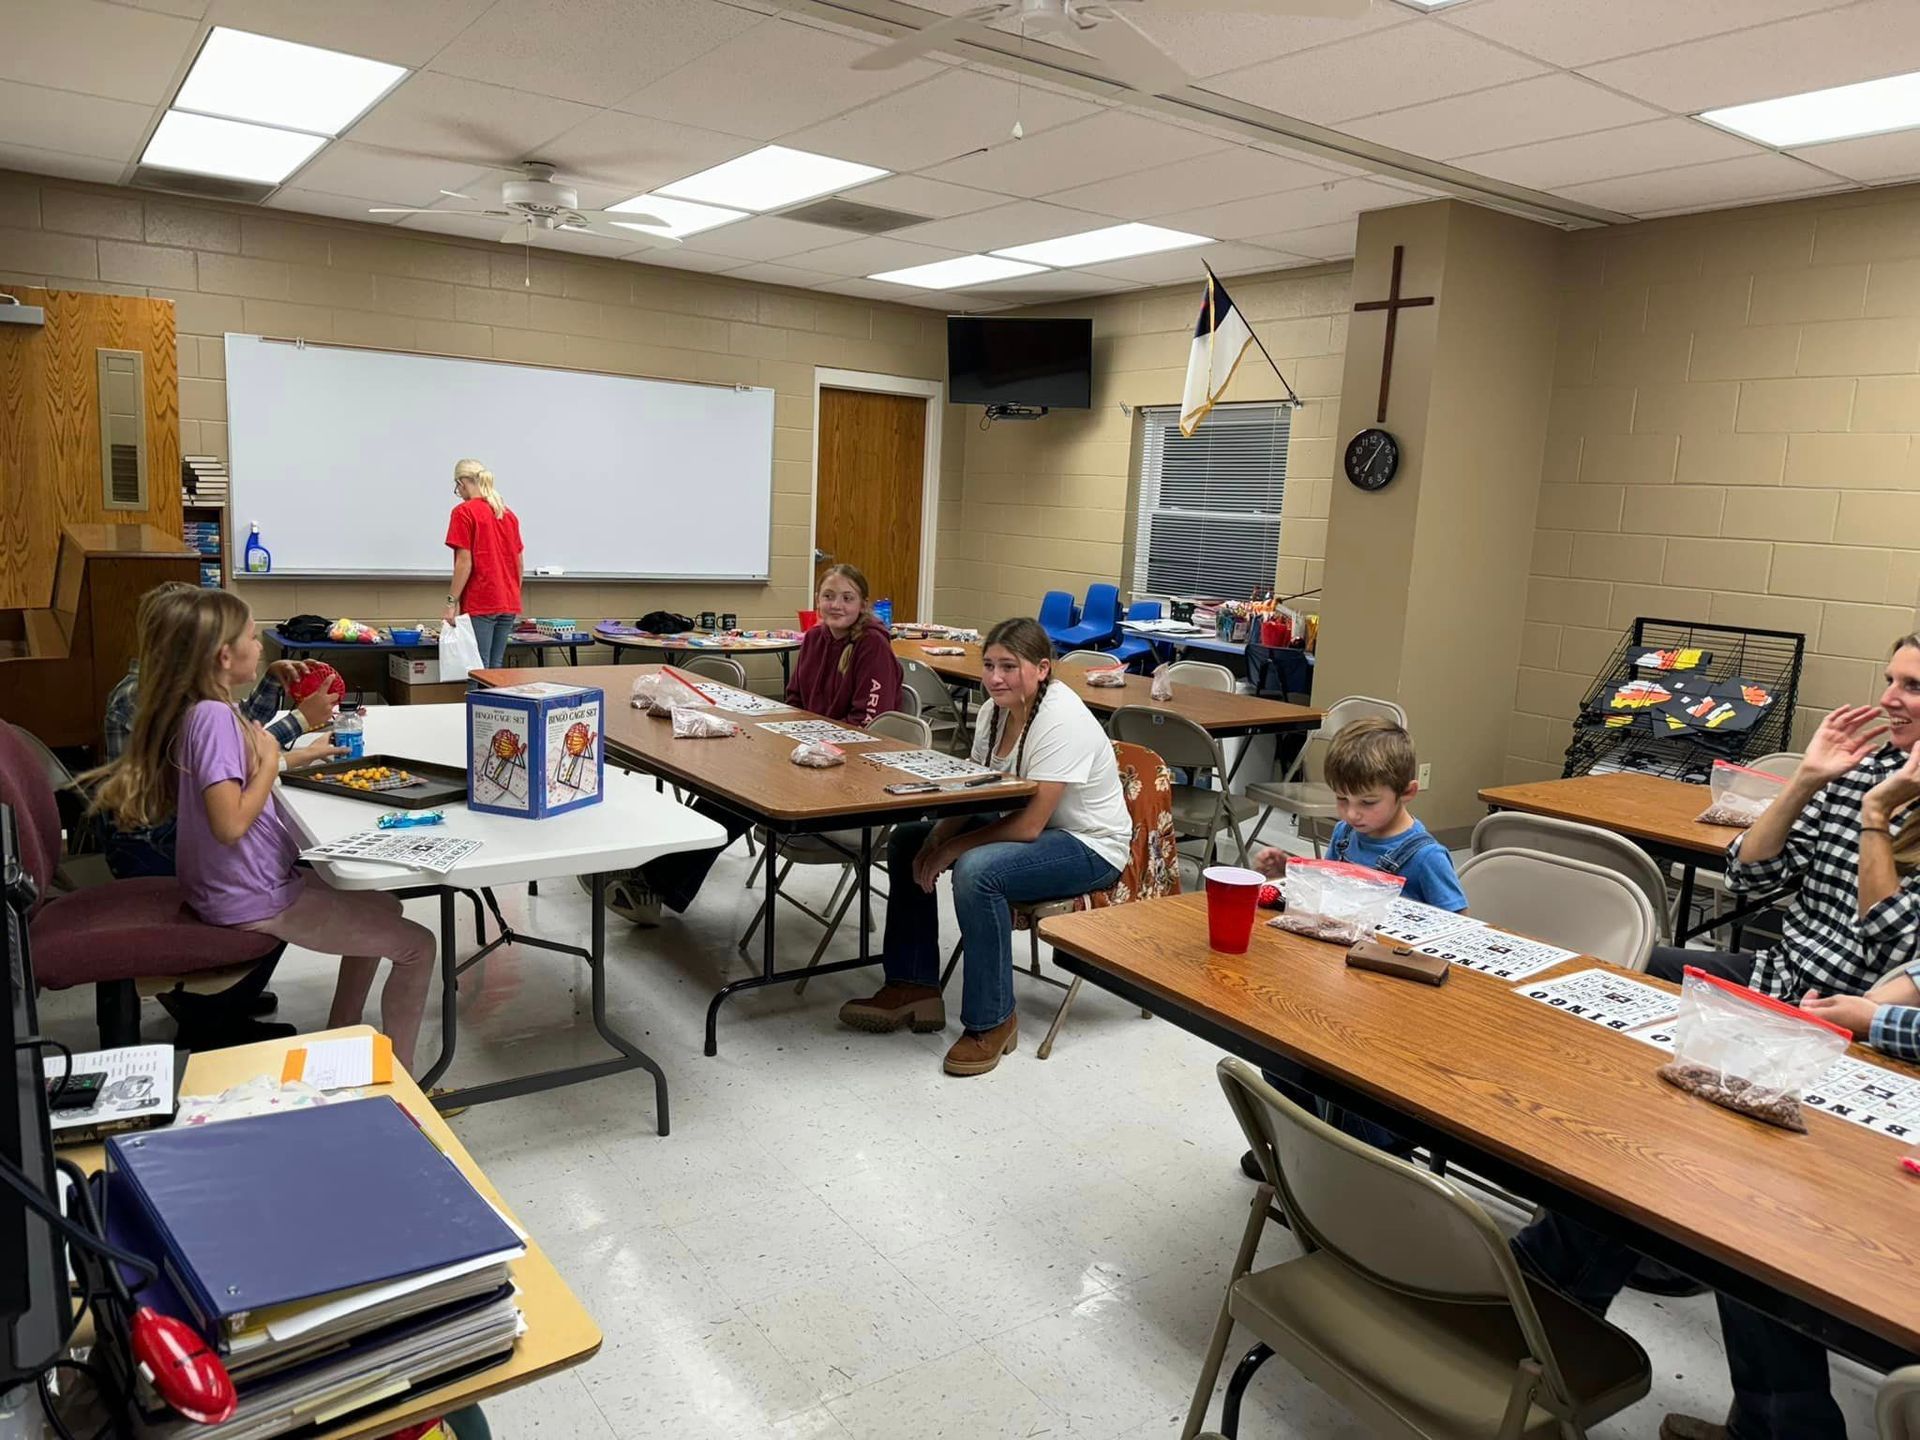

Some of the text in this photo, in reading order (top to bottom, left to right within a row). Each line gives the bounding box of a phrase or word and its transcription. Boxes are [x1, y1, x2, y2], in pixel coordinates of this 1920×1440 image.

[549, 708, 597, 724] BINGO CAGE SET
[861, 678, 882, 725] ARIA
[1374, 924, 1420, 941] BIN
[1422, 947, 1514, 978] BINGO
[1530, 991, 1631, 1029] BINGO
[1803, 1095, 1912, 1136] BING
